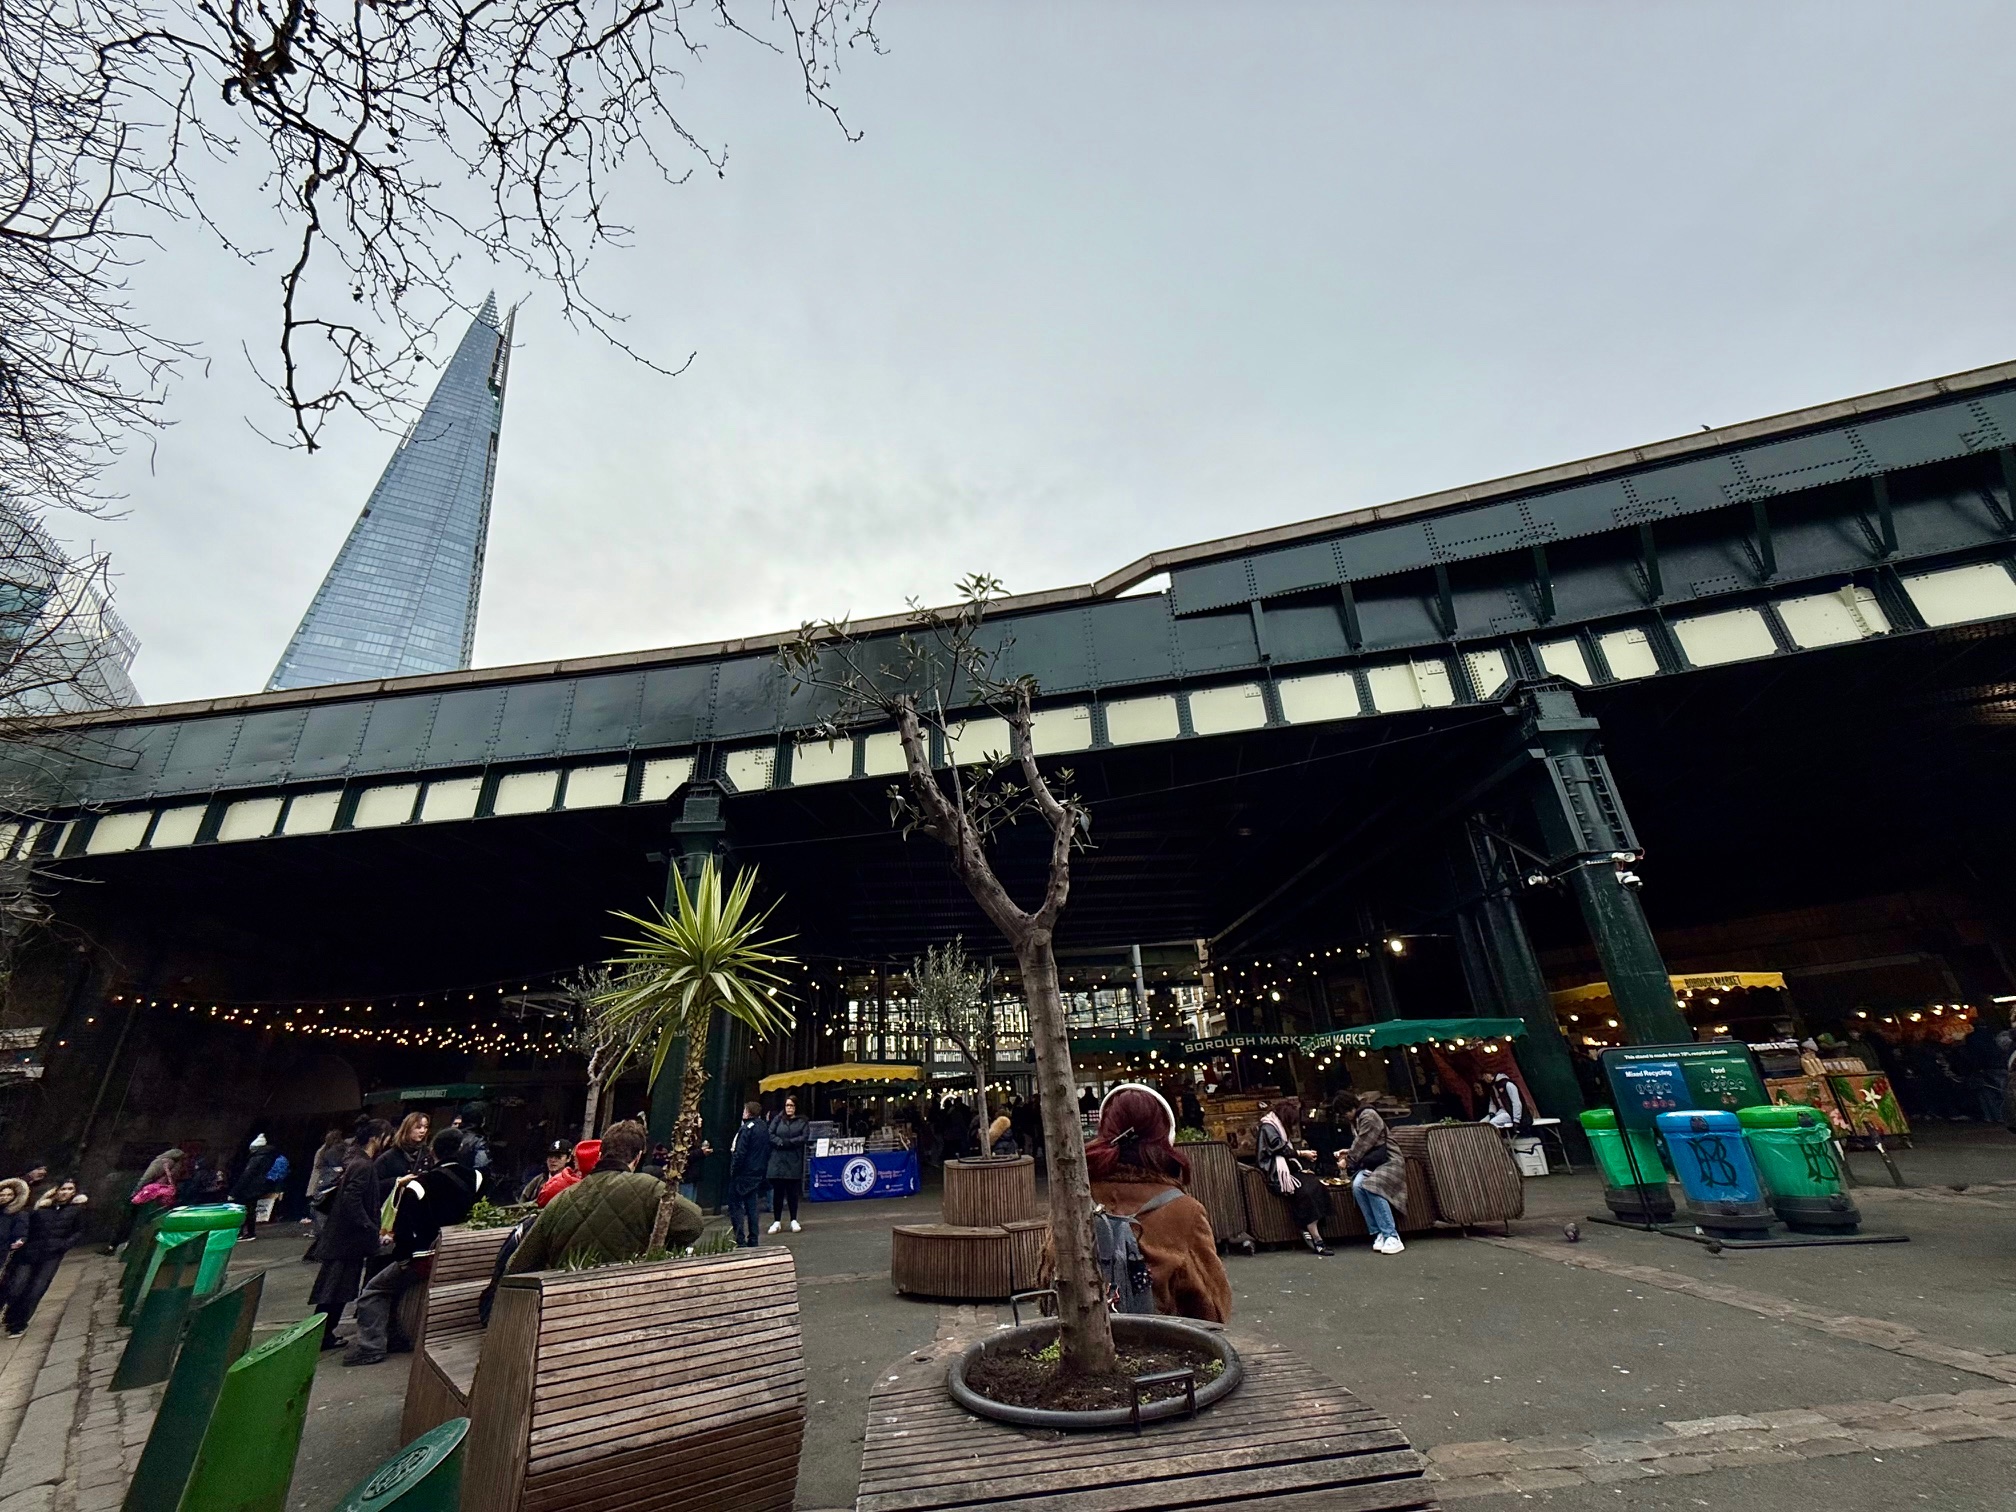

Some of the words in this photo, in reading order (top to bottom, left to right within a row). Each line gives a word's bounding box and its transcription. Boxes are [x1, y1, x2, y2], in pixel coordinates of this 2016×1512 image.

[1684, 977, 1715, 988] BOROUGH
[1713, 975, 1742, 986] MARKET
[1184, 1036, 1256, 1053] BOROUGH
[1333, 1033, 1372, 1046] MARKET
[1625, 1070, 1643, 1078] Mixed
[1643, 1069, 1673, 1077] Recycling
